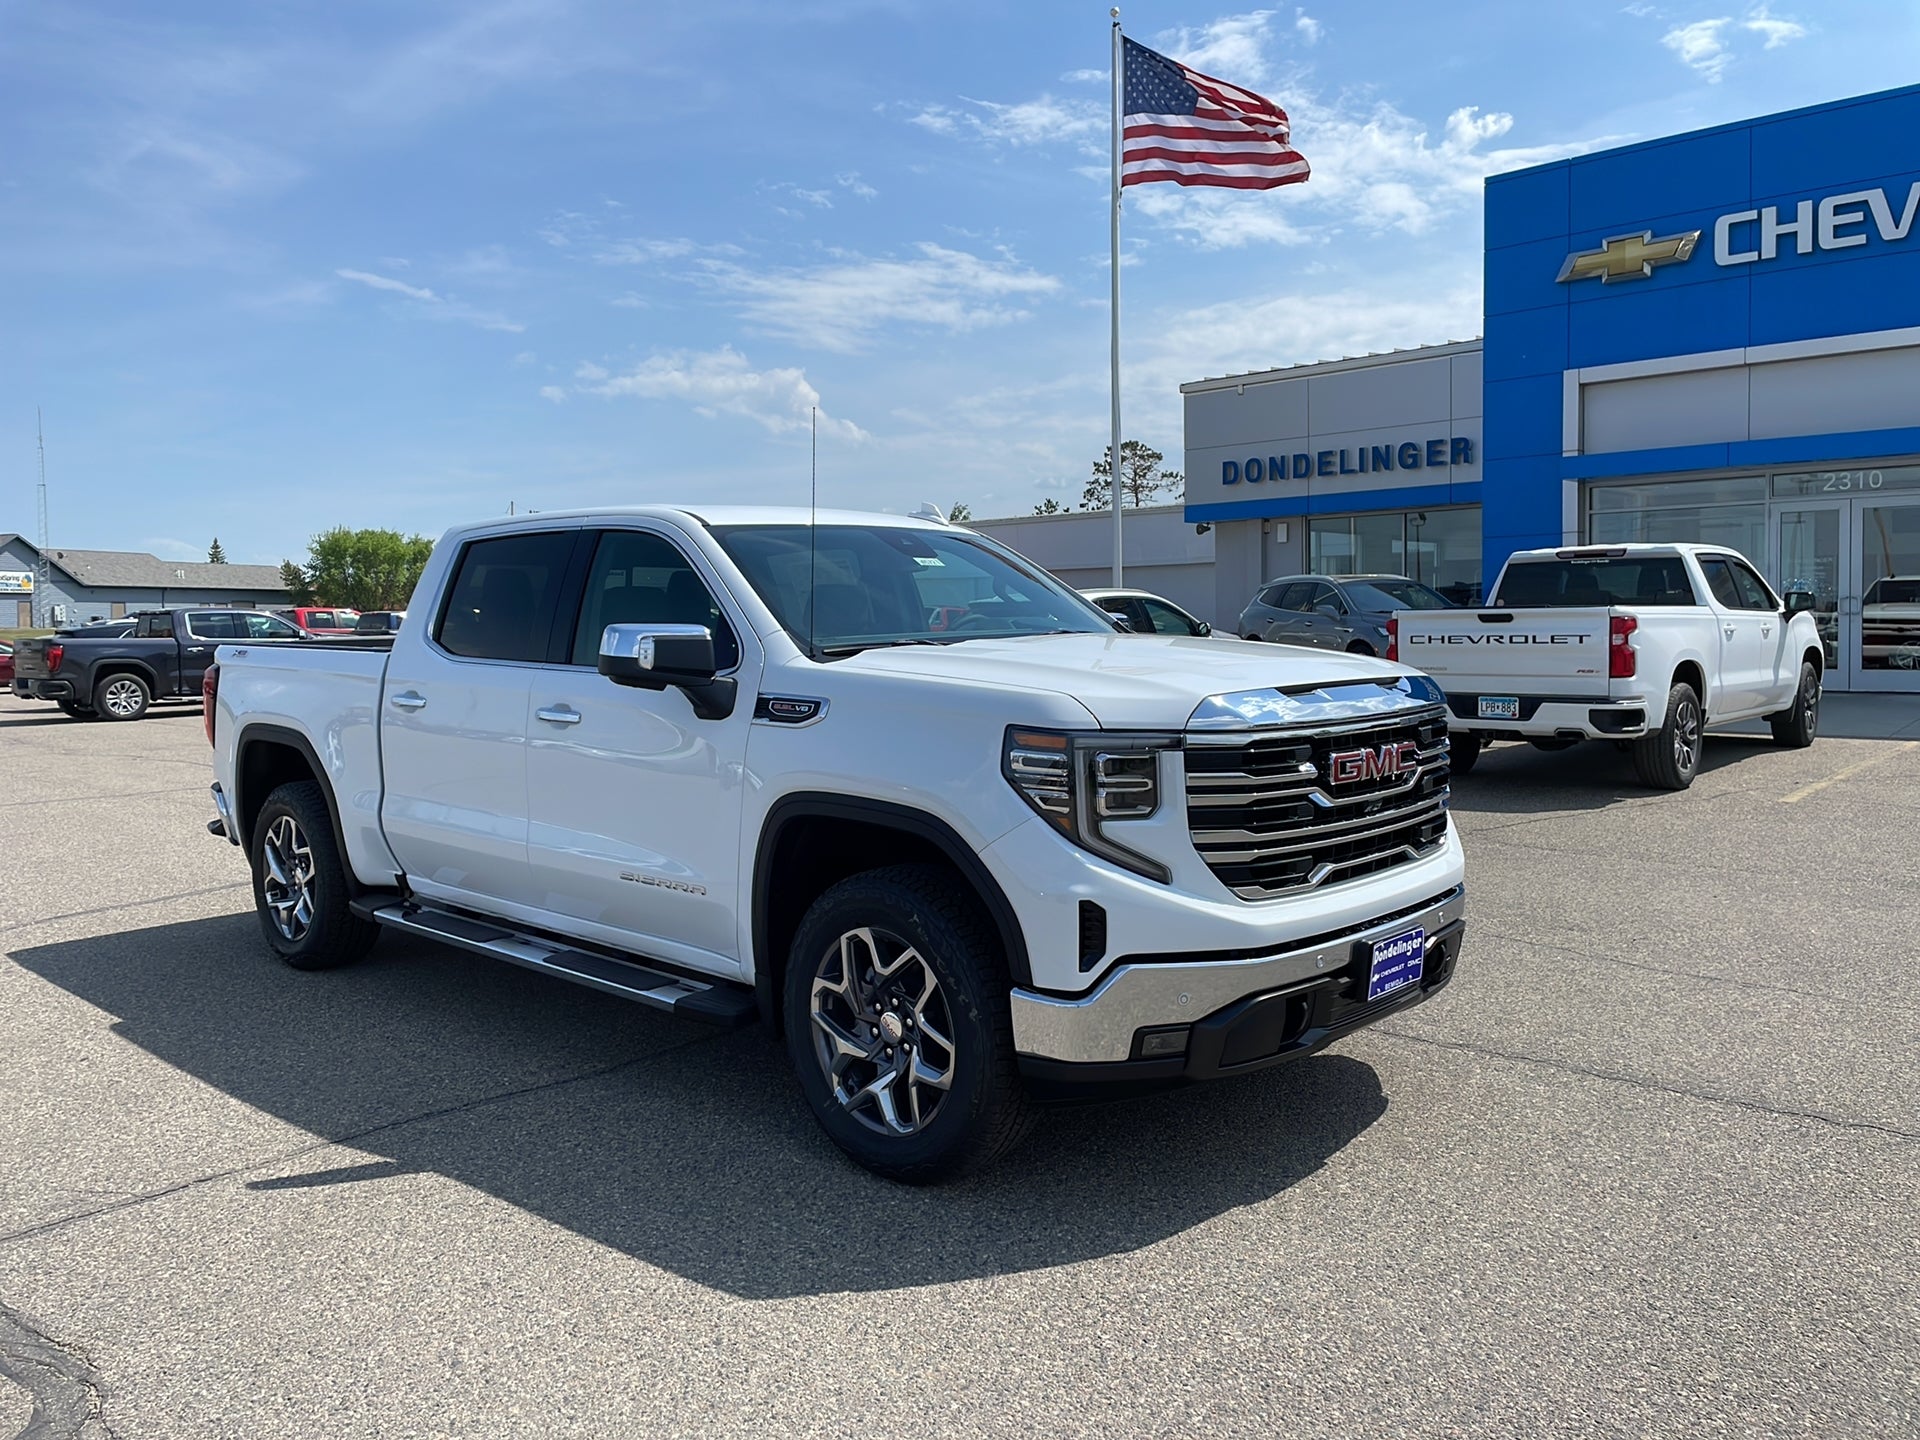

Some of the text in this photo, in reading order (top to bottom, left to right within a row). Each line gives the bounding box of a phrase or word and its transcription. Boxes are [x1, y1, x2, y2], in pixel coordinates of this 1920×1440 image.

[1222, 437, 1474, 485] DONDELINGER
[1823, 470, 1883, 491] 2310
[1409, 634, 1592, 645] CHEVROLET
[1330, 741, 1416, 785] GMC
[619, 870, 707, 896] SIERRA
[1374, 937, 1422, 965] Dondelinger
[1407, 957, 1422, 967] GMC
